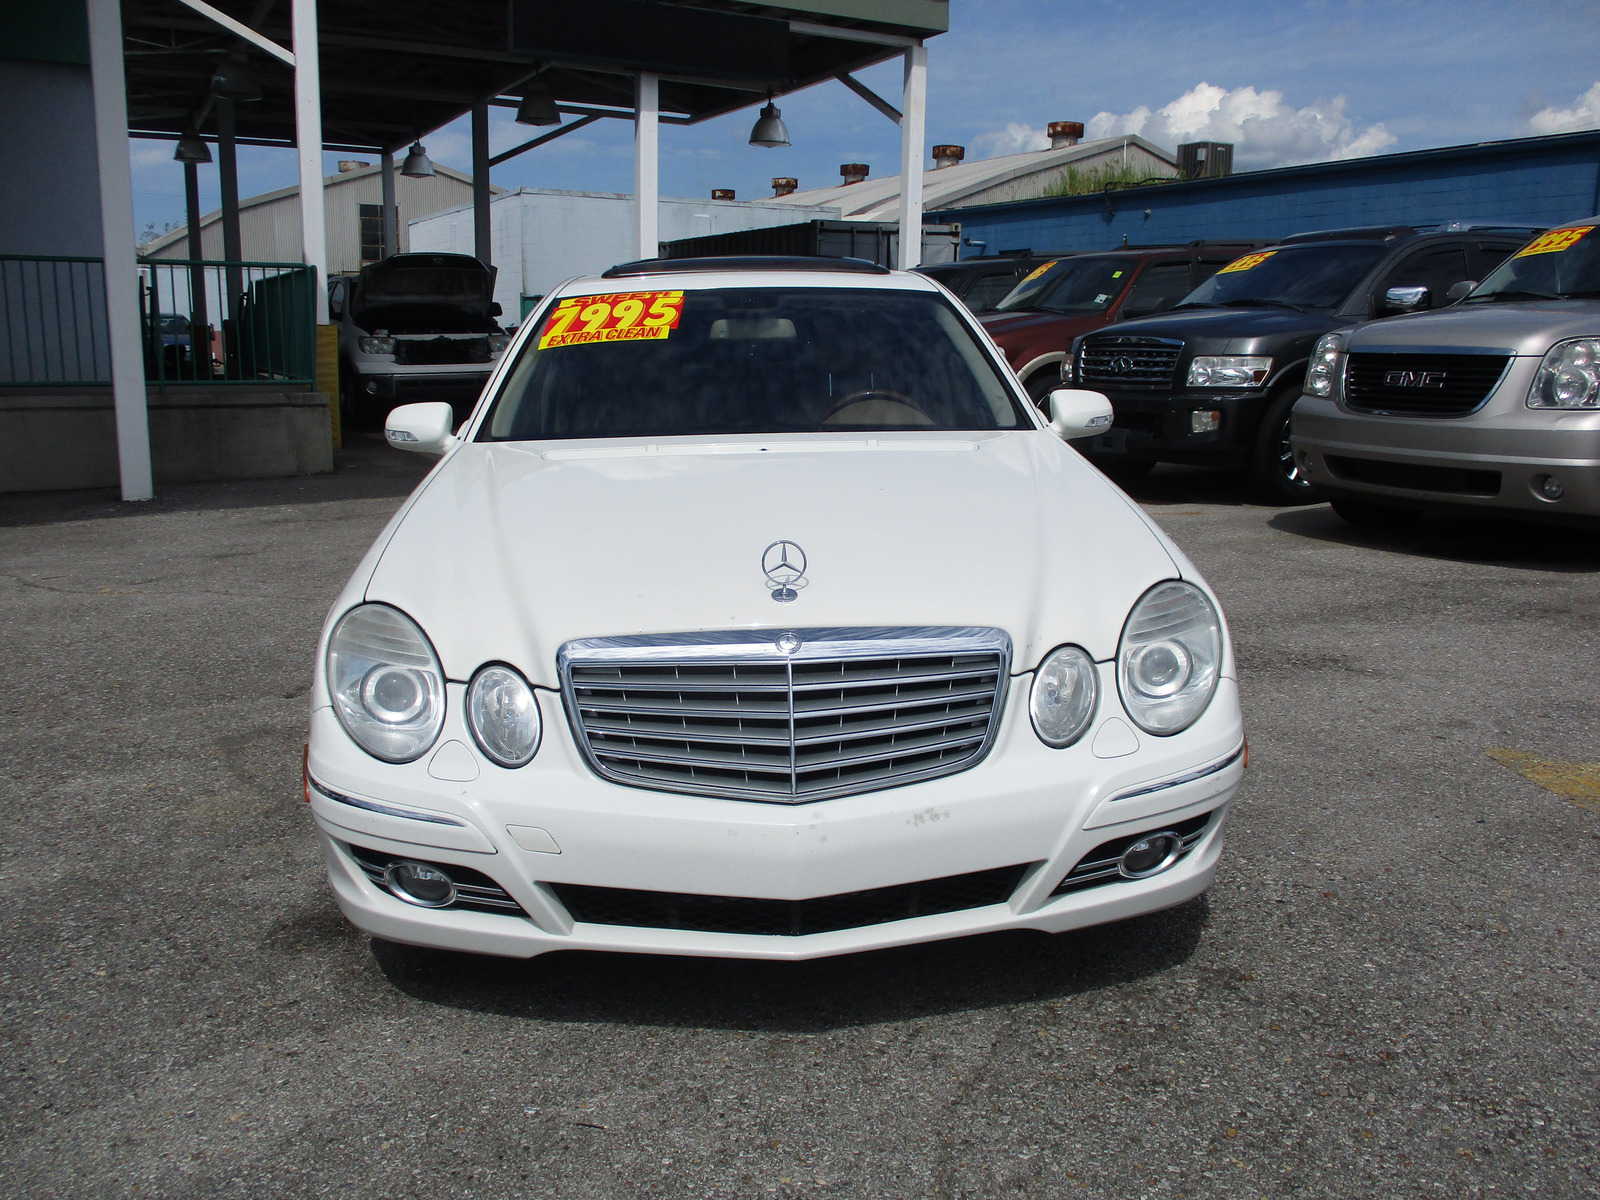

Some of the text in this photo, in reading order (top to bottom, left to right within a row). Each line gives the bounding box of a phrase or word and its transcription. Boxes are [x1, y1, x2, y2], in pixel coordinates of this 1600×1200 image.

[547, 297, 681, 335] 7995
[547, 326, 661, 347] EXTRA CLEAN
[1384, 370, 1447, 389] GMC
